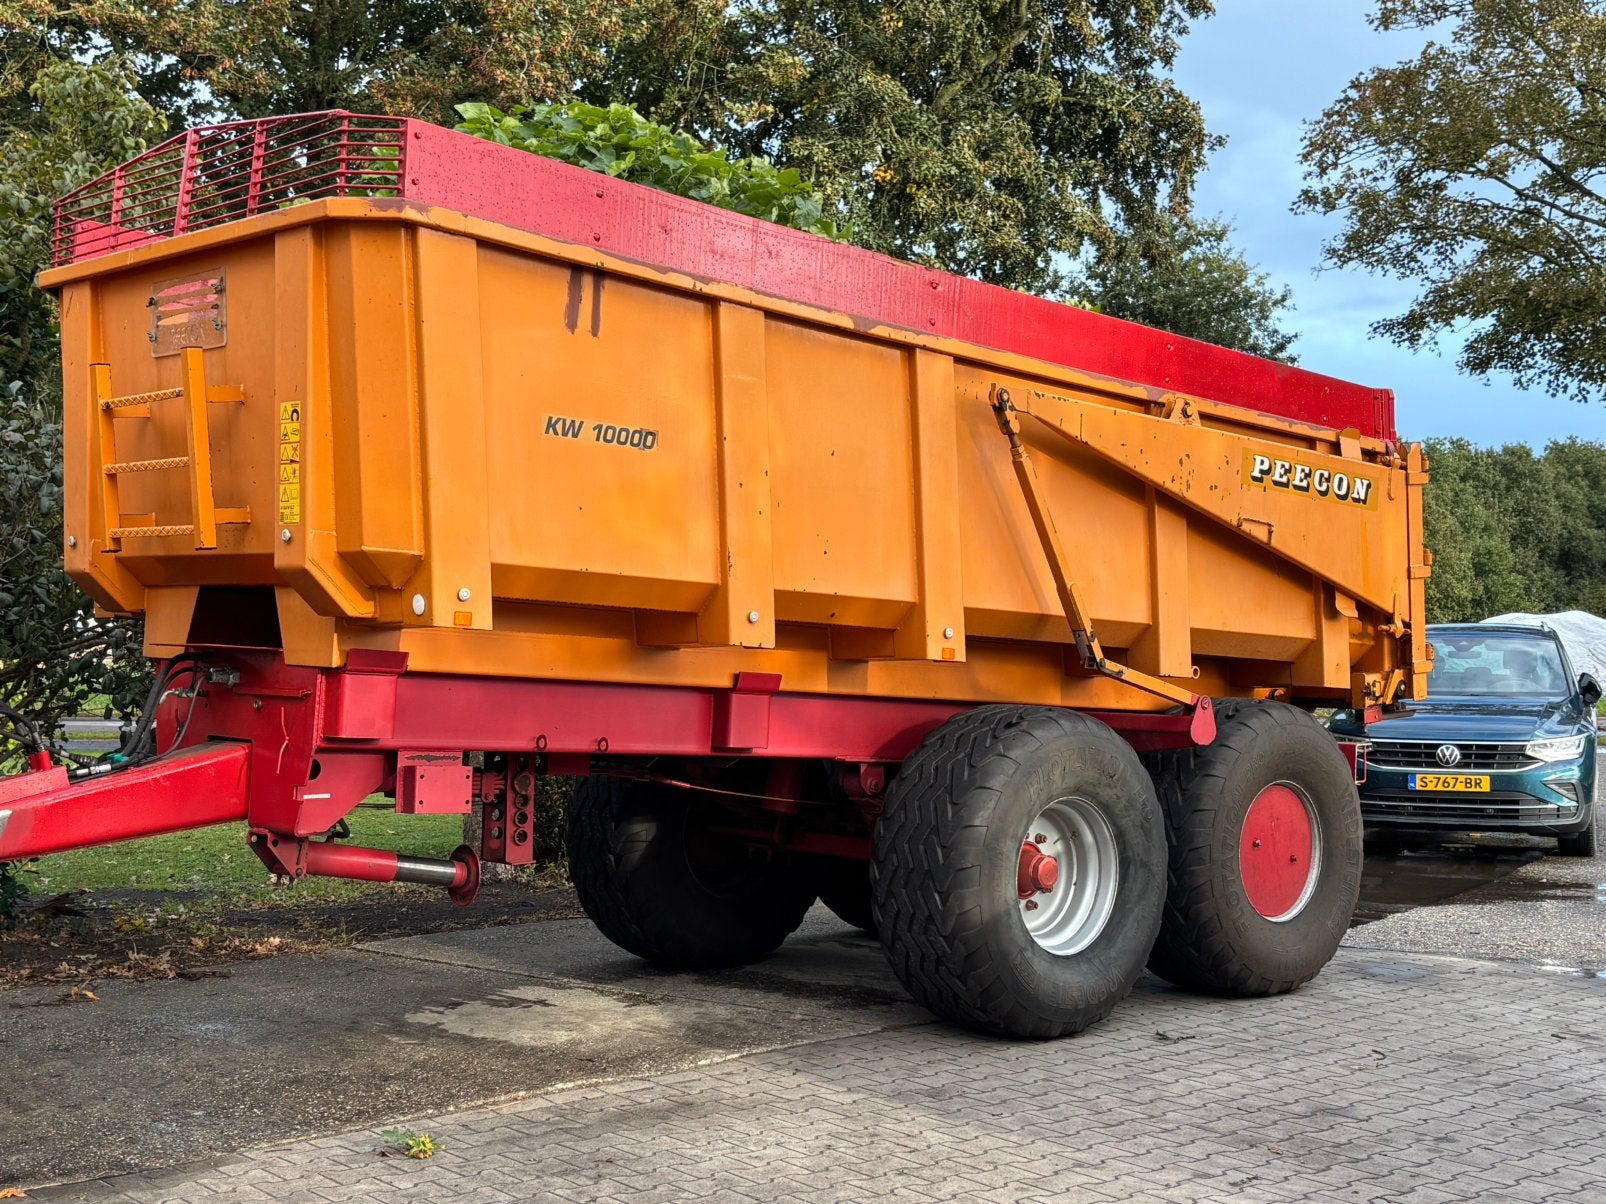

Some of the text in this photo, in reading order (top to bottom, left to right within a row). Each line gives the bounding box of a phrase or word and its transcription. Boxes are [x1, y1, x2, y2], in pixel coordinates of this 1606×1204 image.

[544, 415, 657, 450] KW 10000
[1250, 454, 1372, 505] PEECON
[1419, 776, 1483, 790] S-767-BR
